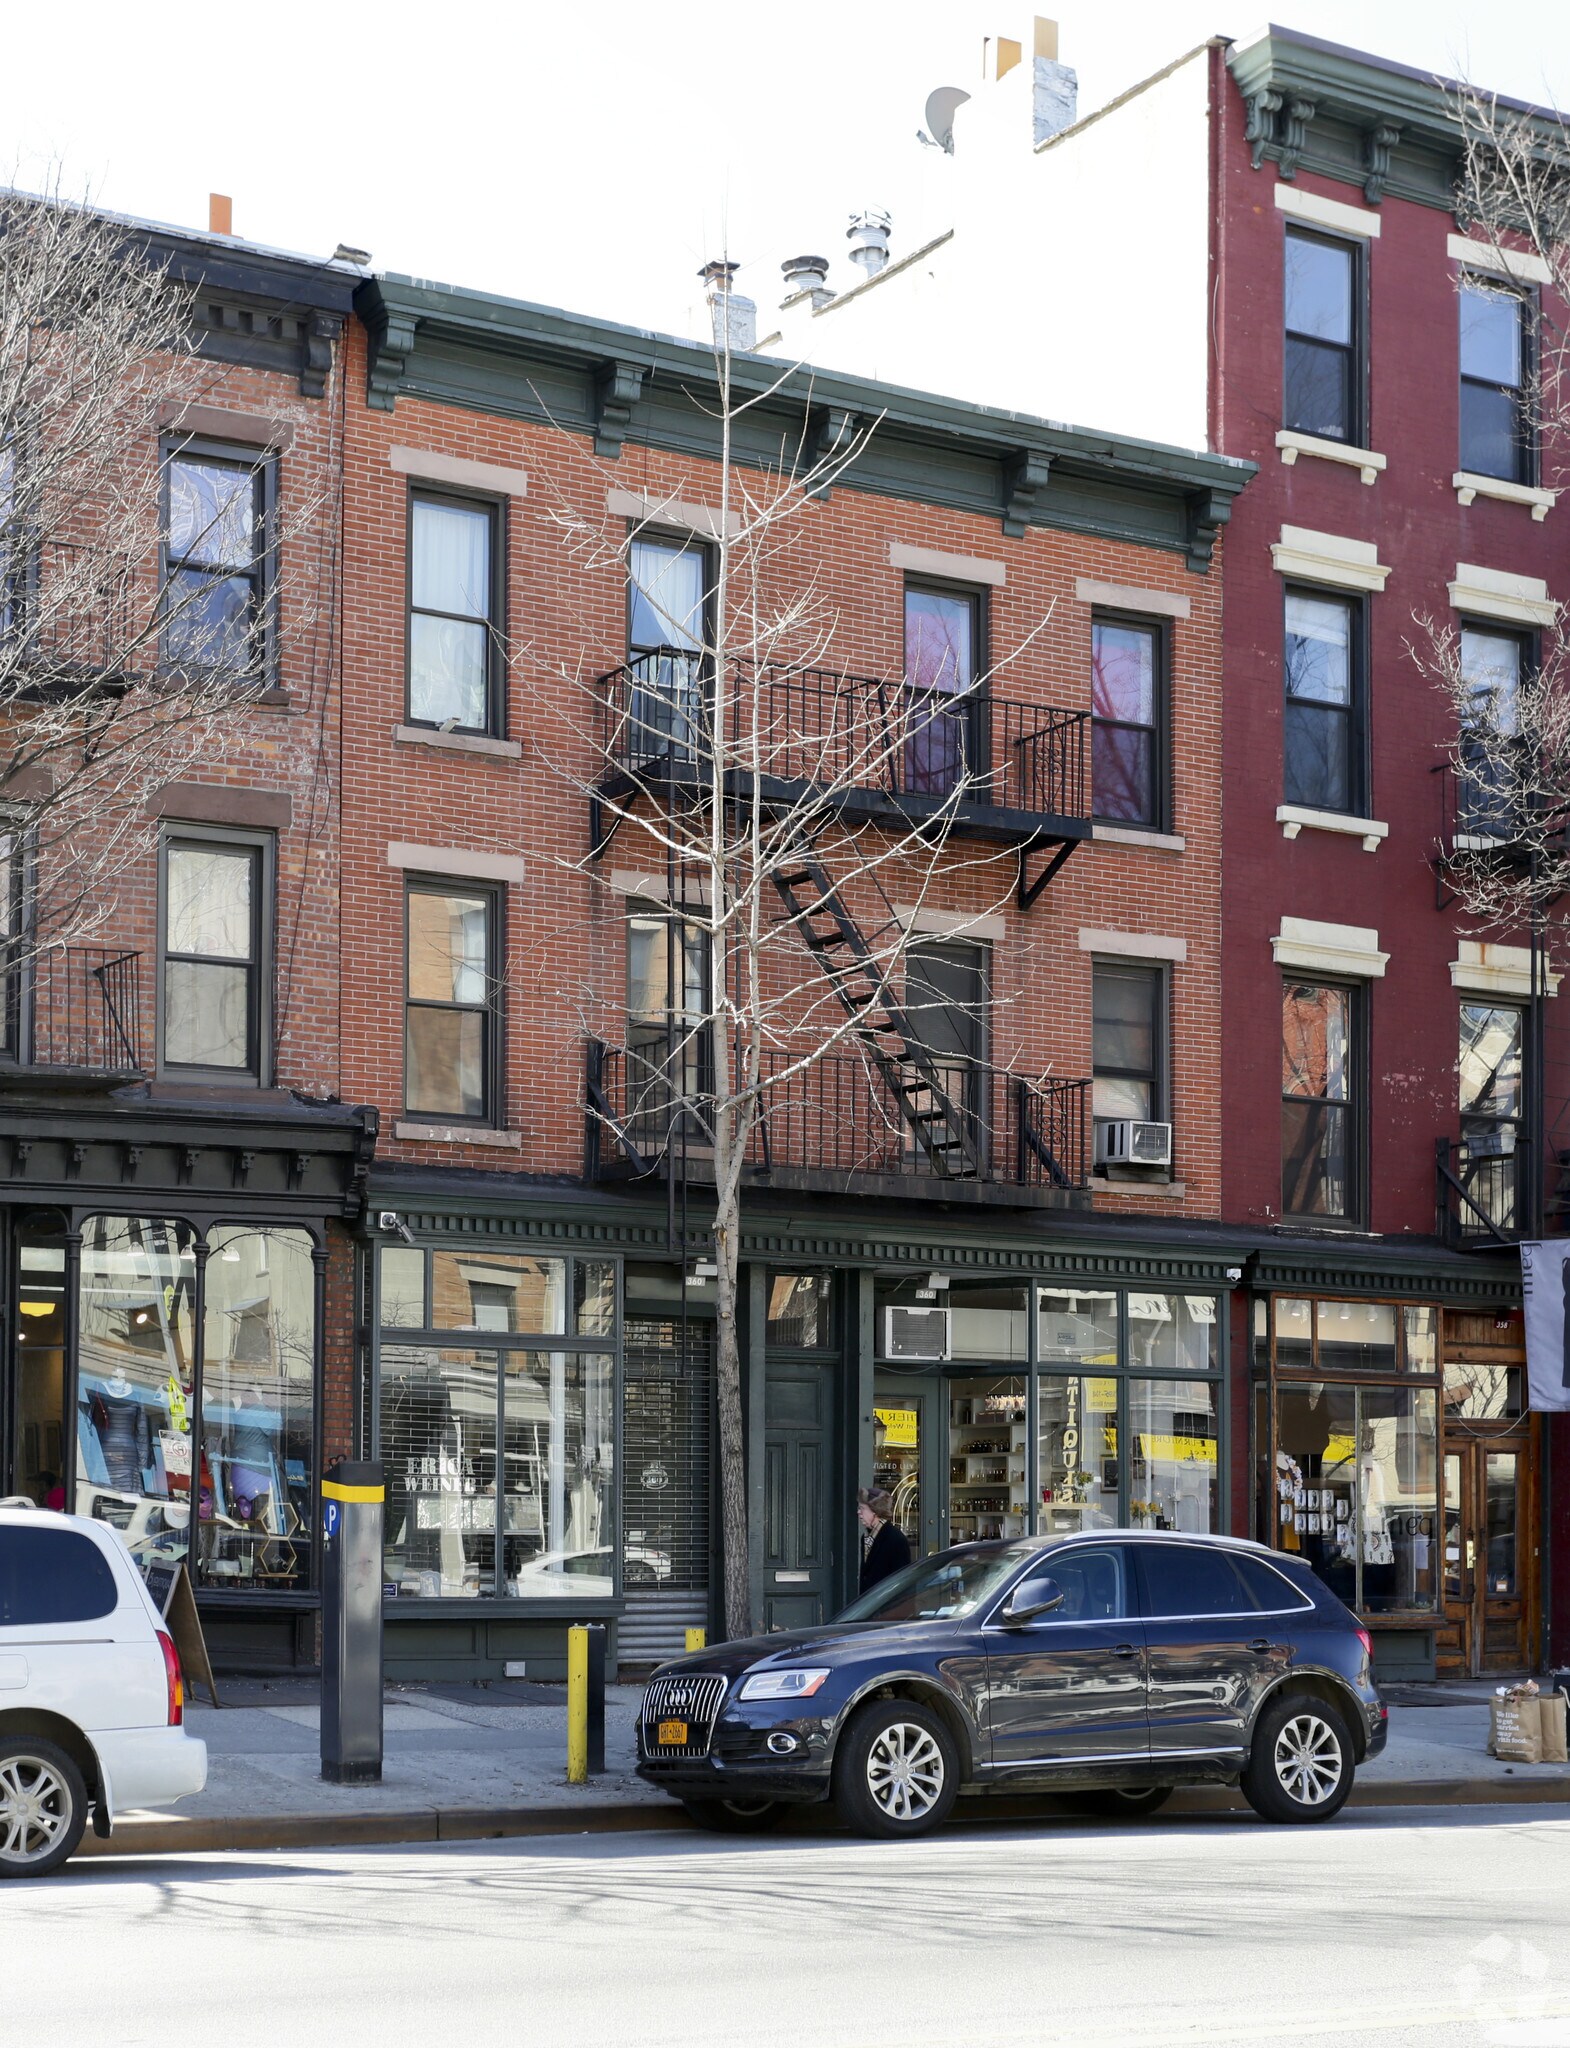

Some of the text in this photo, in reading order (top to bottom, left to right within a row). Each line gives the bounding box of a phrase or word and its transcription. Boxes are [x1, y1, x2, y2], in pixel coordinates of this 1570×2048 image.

[1521, 1242, 1543, 1294] meg
[687, 1277, 702, 1286] 360
[919, 1290, 934, 1298] 360
[1496, 1321, 1508, 1329] 358
[405, 1456, 475, 1475] ERICA
[403, 1476, 477, 1492] WEINER
[328, 1504, 337, 1532] P
